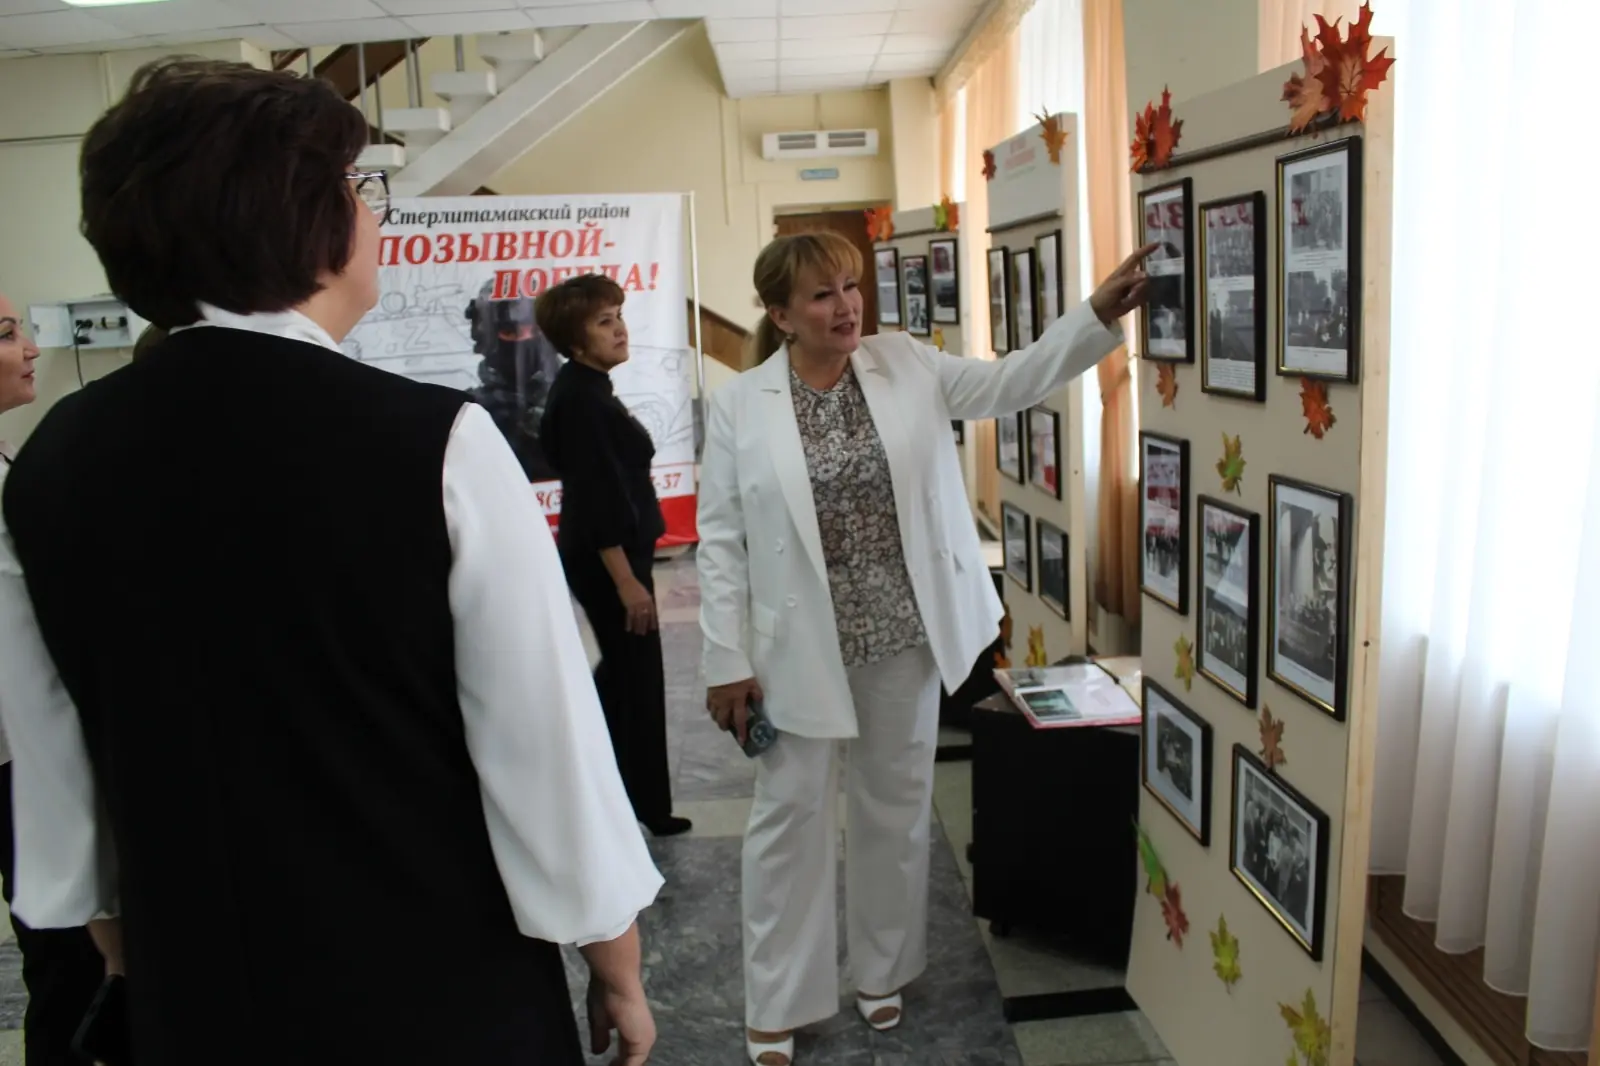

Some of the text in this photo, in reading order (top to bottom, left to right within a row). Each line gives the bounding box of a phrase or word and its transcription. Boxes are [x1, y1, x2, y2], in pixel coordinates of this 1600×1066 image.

[388, 202, 630, 229] Стерлитамакский район
[378, 221, 615, 267] ПОЗЫВНОЙ-
